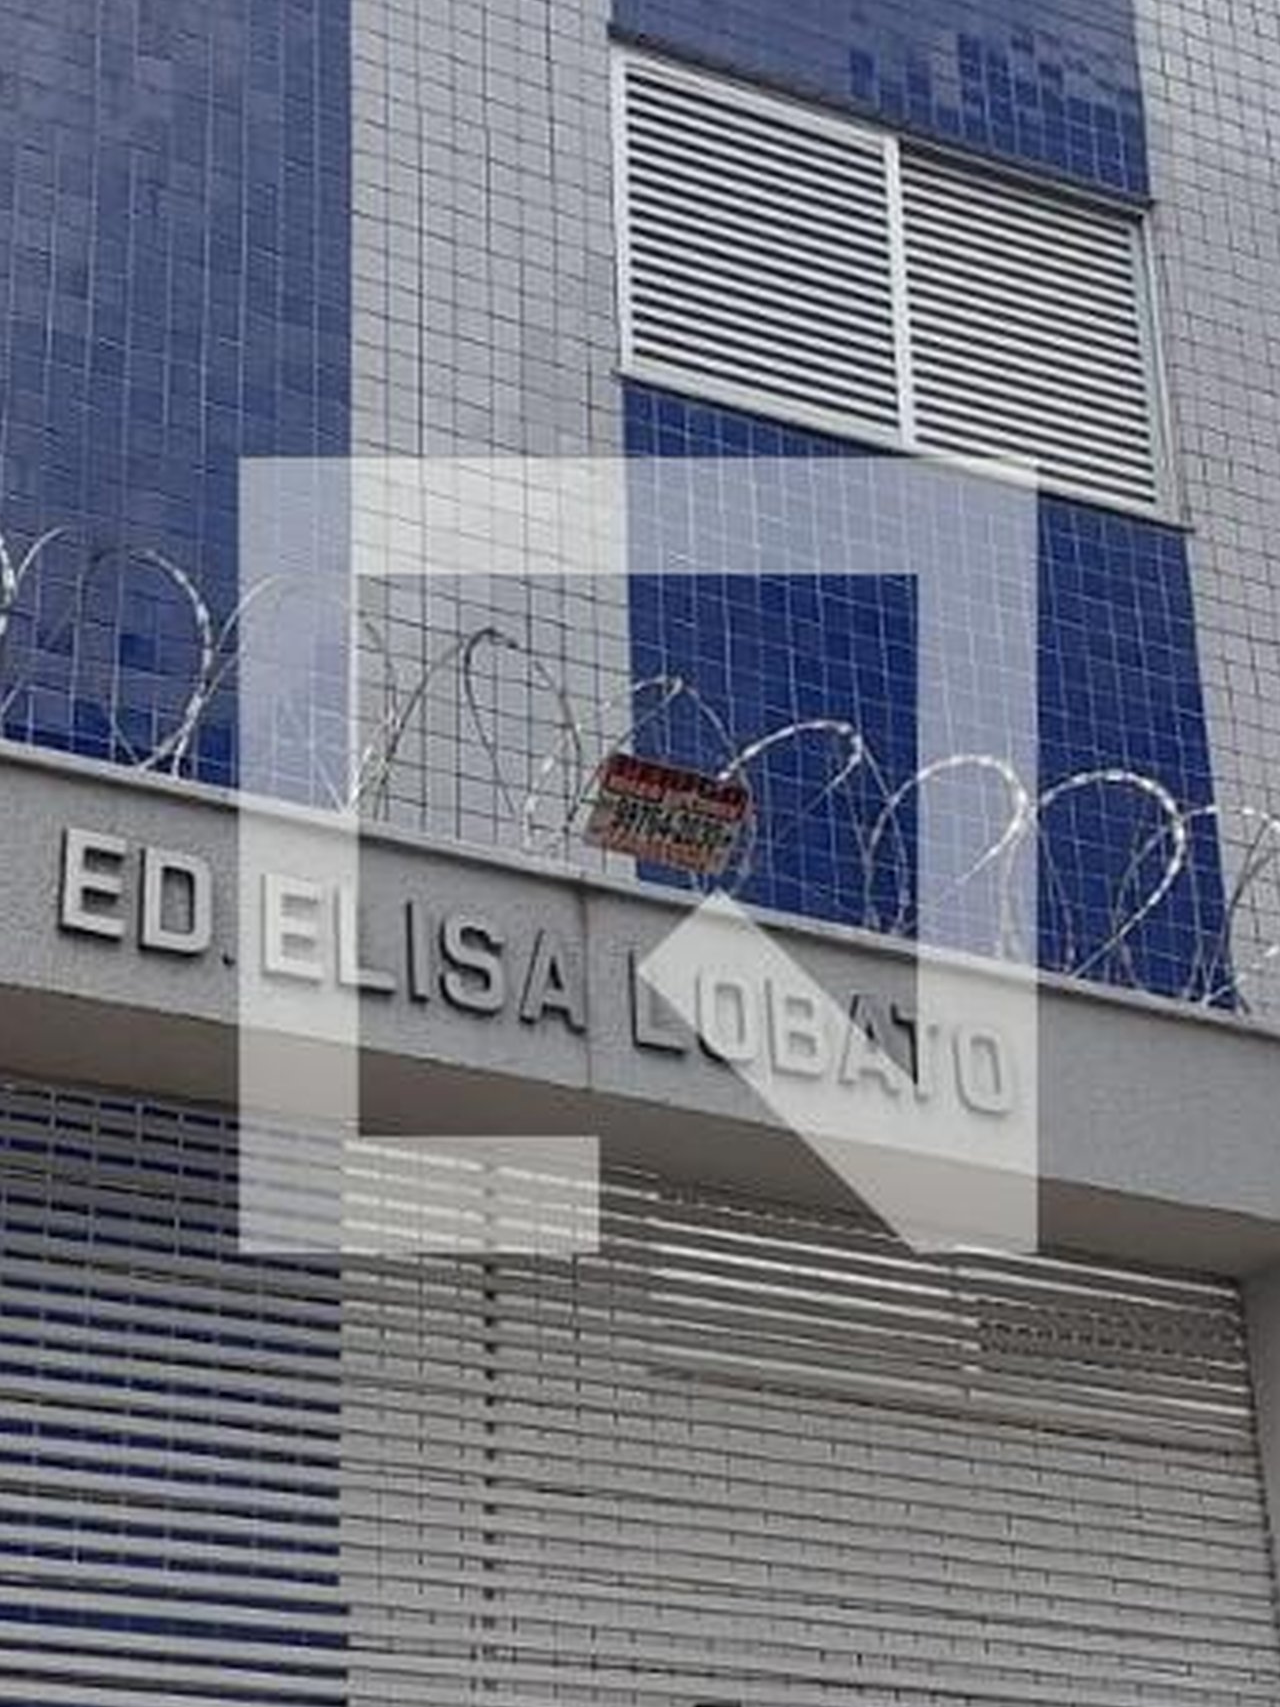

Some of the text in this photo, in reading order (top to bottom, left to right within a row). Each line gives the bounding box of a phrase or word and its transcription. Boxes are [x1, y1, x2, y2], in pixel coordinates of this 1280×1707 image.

[58, 827, 1014, 1117] ED. ELISA LOBATO
